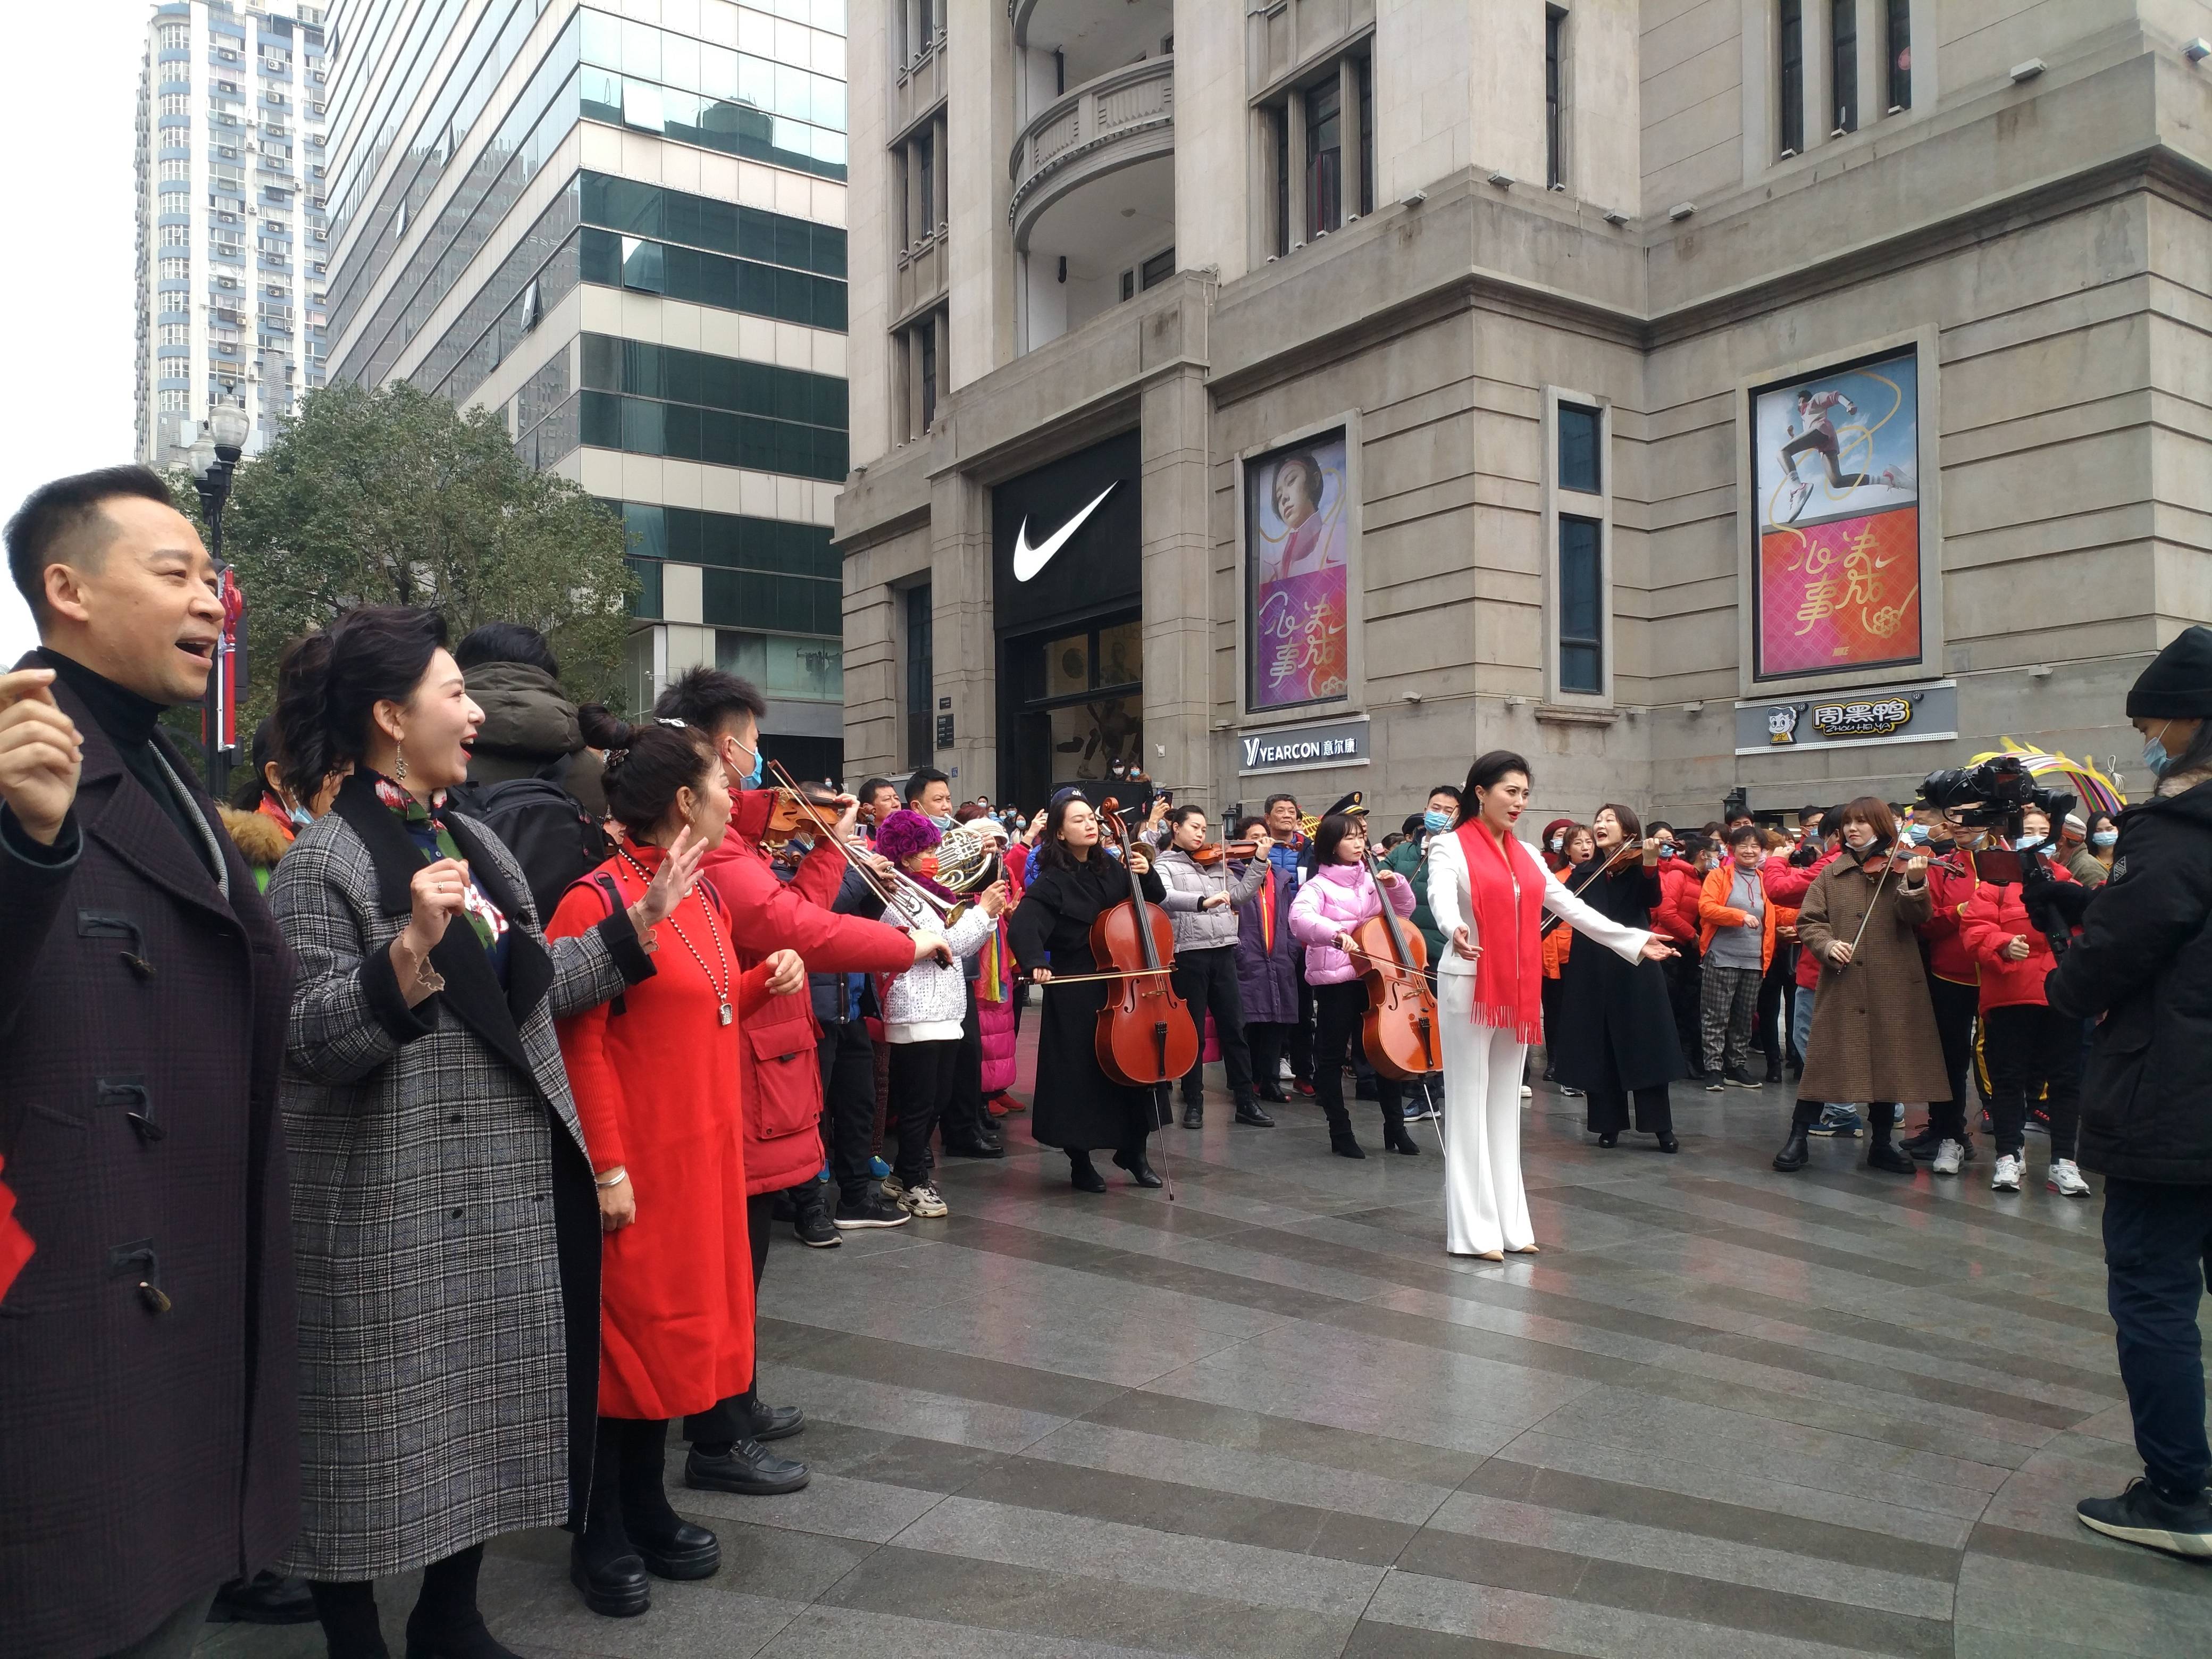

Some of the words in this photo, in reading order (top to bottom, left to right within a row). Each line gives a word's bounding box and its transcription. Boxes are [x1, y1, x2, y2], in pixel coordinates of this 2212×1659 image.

[1832, 646, 1850, 657] NIKE
[1814, 700, 1906, 726] 周黑鸭
[1825, 724, 1855, 733] ZHOU
[1857, 723, 1873, 731] HEI
[1874, 722, 1891, 731] YA
[1260, 742, 1320, 762] YEARCON
[1323, 738, 1356, 756] 意尔康
